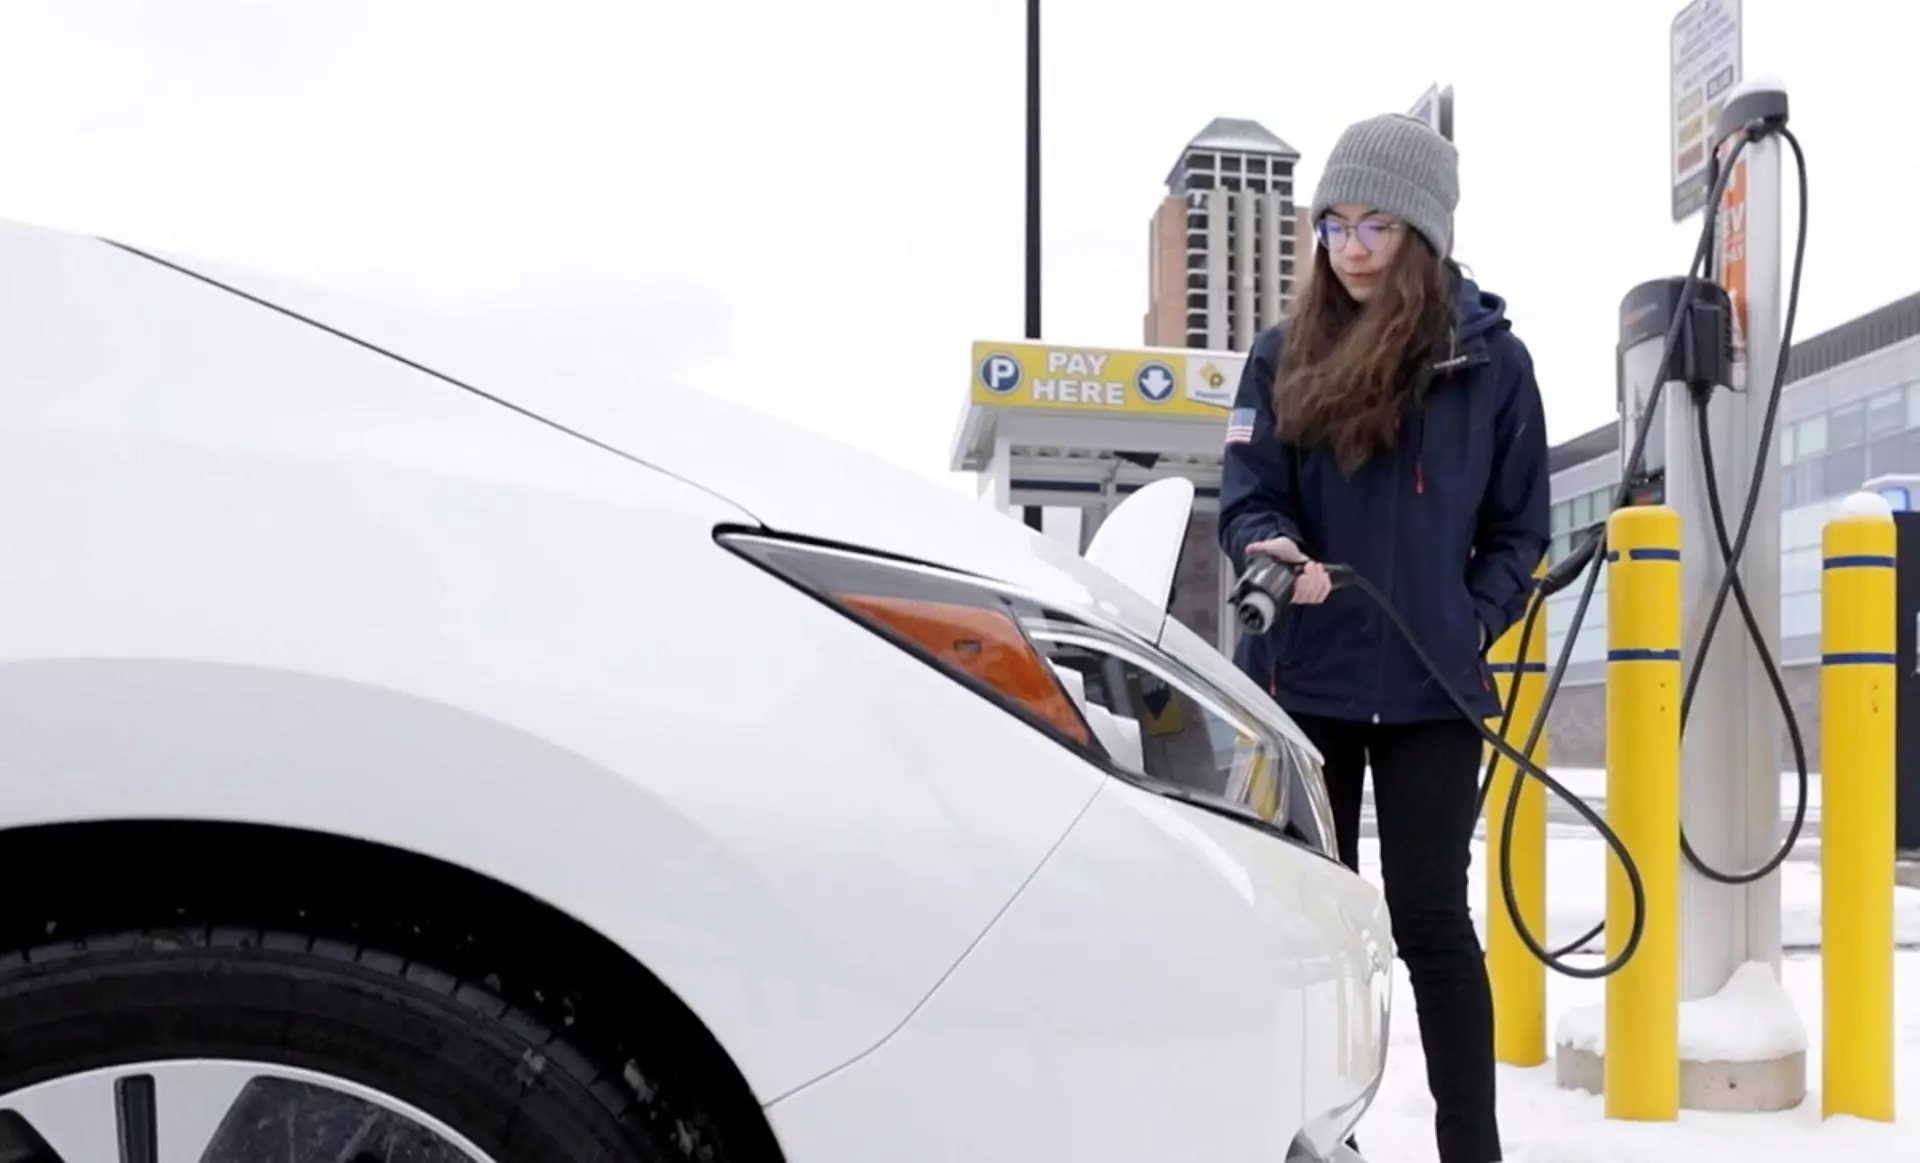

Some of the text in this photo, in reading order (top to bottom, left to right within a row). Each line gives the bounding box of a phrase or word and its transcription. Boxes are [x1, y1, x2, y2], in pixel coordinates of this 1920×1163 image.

[990, 358, 1014, 389] P
[1049, 352, 1109, 376] PAY
[1032, 378, 1125, 405] HERE
